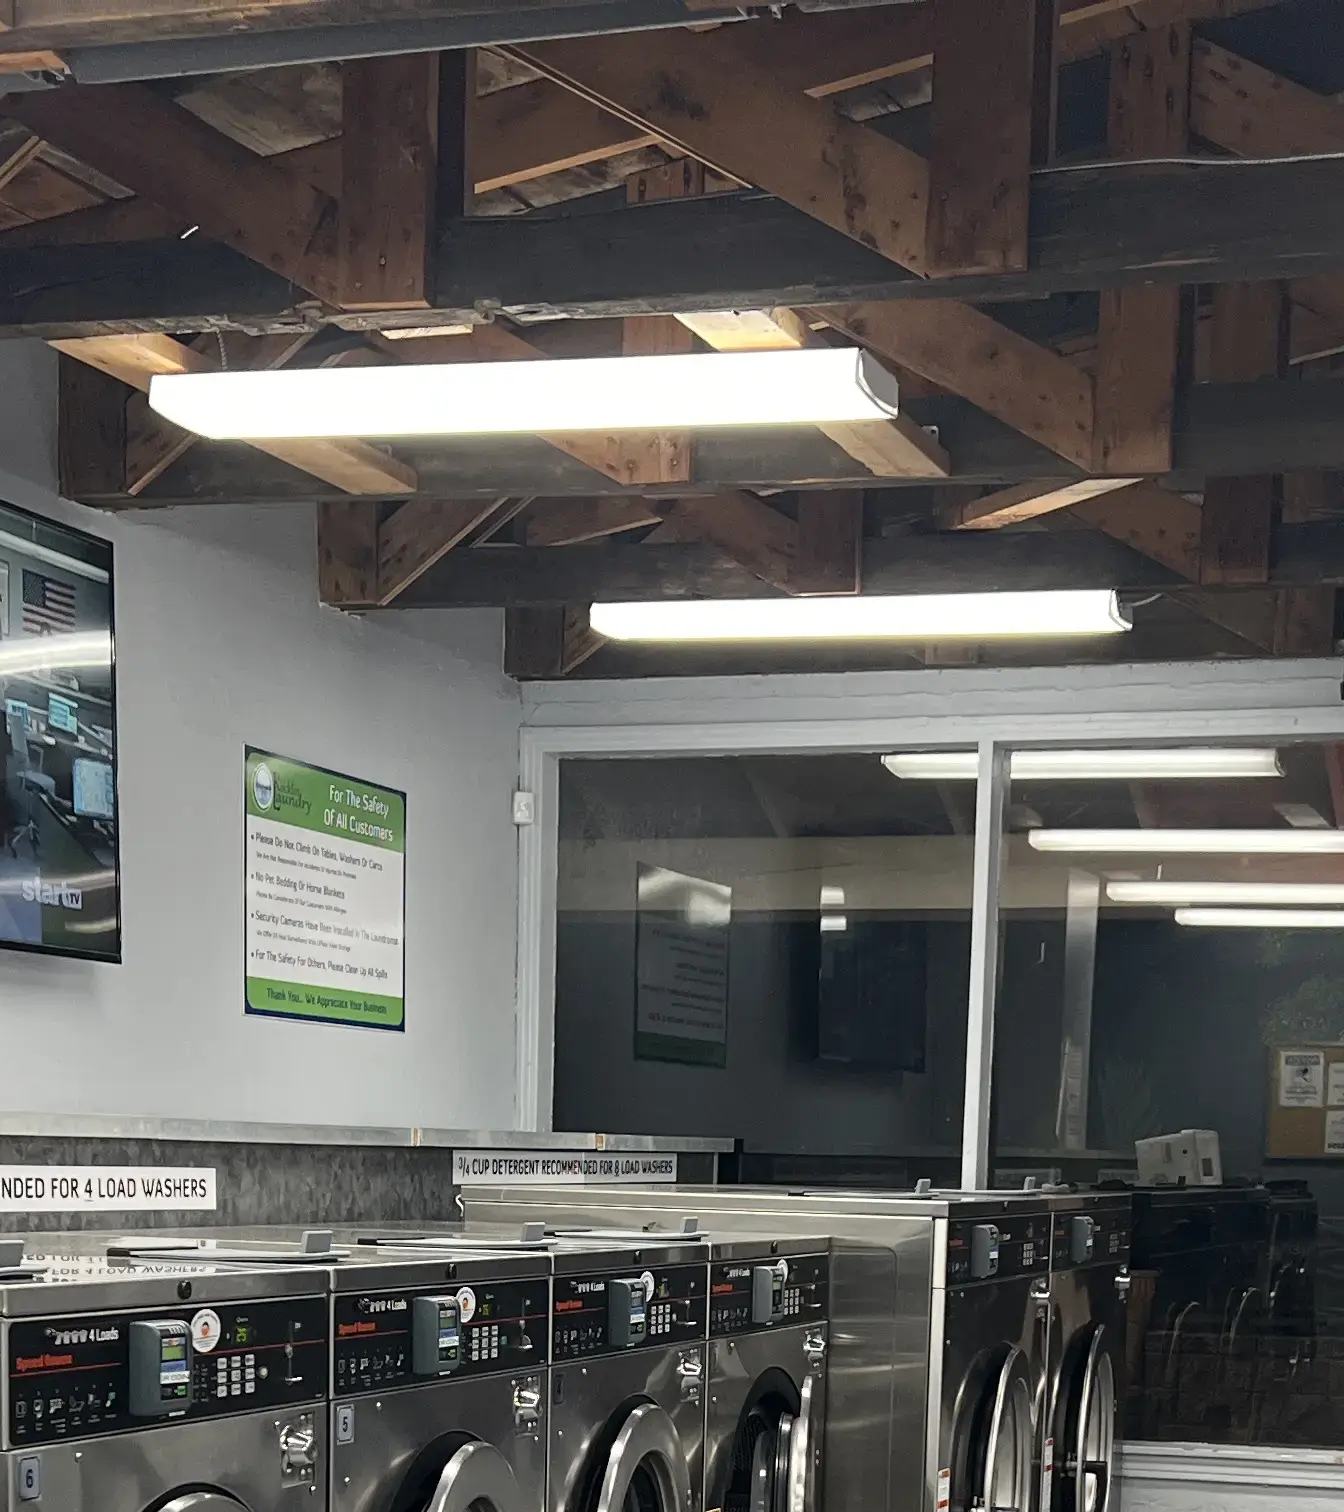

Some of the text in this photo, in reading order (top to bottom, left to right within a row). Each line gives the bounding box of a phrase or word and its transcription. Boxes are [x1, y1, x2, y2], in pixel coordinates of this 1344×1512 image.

[329, 784, 389, 820] For The Safety
[336, 812, 348, 830] All
[349, 816, 393, 842] Customers
[255, 832, 274, 846] Please
[275, 836, 283, 846] Do
[276, 875, 297, 892] Bedding
[298, 880, 306, 891] Or
[306, 882, 323, 895] Horse
[255, 910, 280, 926] Security
[280, 914, 304, 929] Cameras
[255, 948, 266, 961] For
[266, 950, 277, 963] The
[327, 960, 344, 974] Please
[266, 987, 286, 1001] Thank
[472, 1158, 490, 1176] CUP
[491, 1159, 540, 1176] DETERGENT
[541, 1159, 598, 1175] RECOMMENDED
[599, 1159, 613, 1175] FOR
[621, 1159, 640, 1175] LOAD
[641, 1159, 673, 1175] WASHERS
[51, 1178, 79, 1199] FOR
[83, 1178, 93, 1202] 4
[97, 1178, 137, 1199] LOAD
[142, 1178, 207, 1199] WASHERS
[88, 1326, 119, 1342] 4 Loads
[342, 1416, 348, 1433] 5
[26, 1468, 34, 1489] 6
